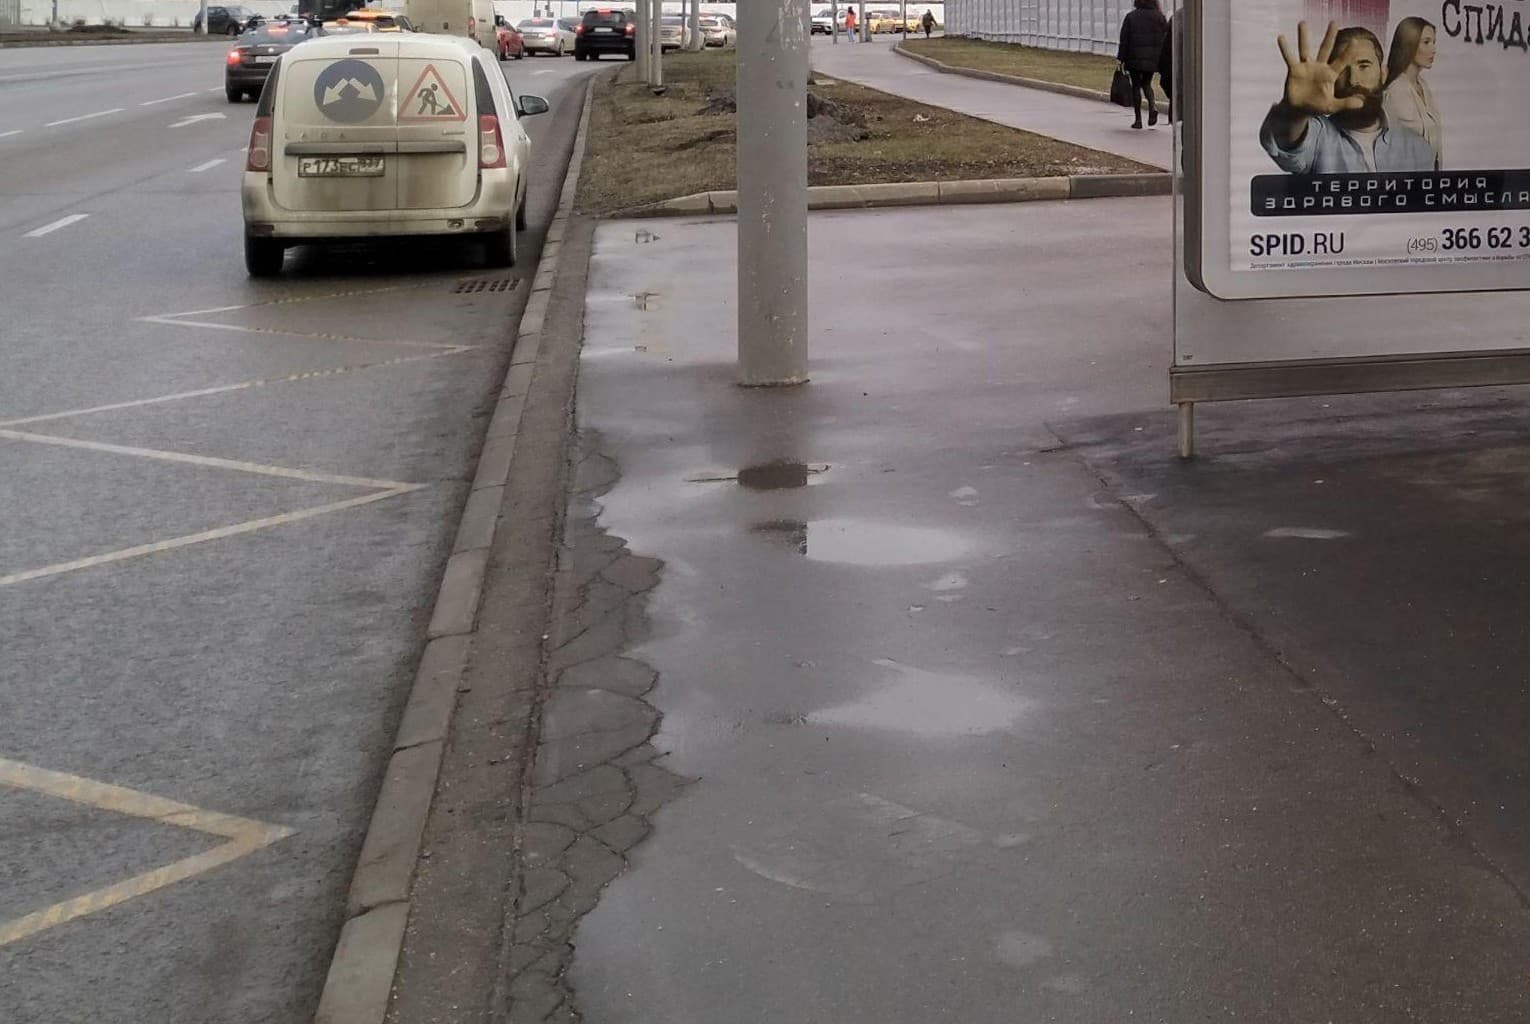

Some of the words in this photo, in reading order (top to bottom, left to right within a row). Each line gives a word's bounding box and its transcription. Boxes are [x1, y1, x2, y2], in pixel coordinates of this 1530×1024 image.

[1311, 177, 1487, 192] ТЕРРИТОРИЯ
[1265, 194, 1408, 209] ЗДРАВОГО
[1425, 191, 1530, 205] СМЫСЛА
[1250, 232, 1345, 257] SPID.RU
[1406, 236, 1438, 254] (495)
[1441, 228, 1481, 251] 366
[1487, 227, 1512, 249] 62
